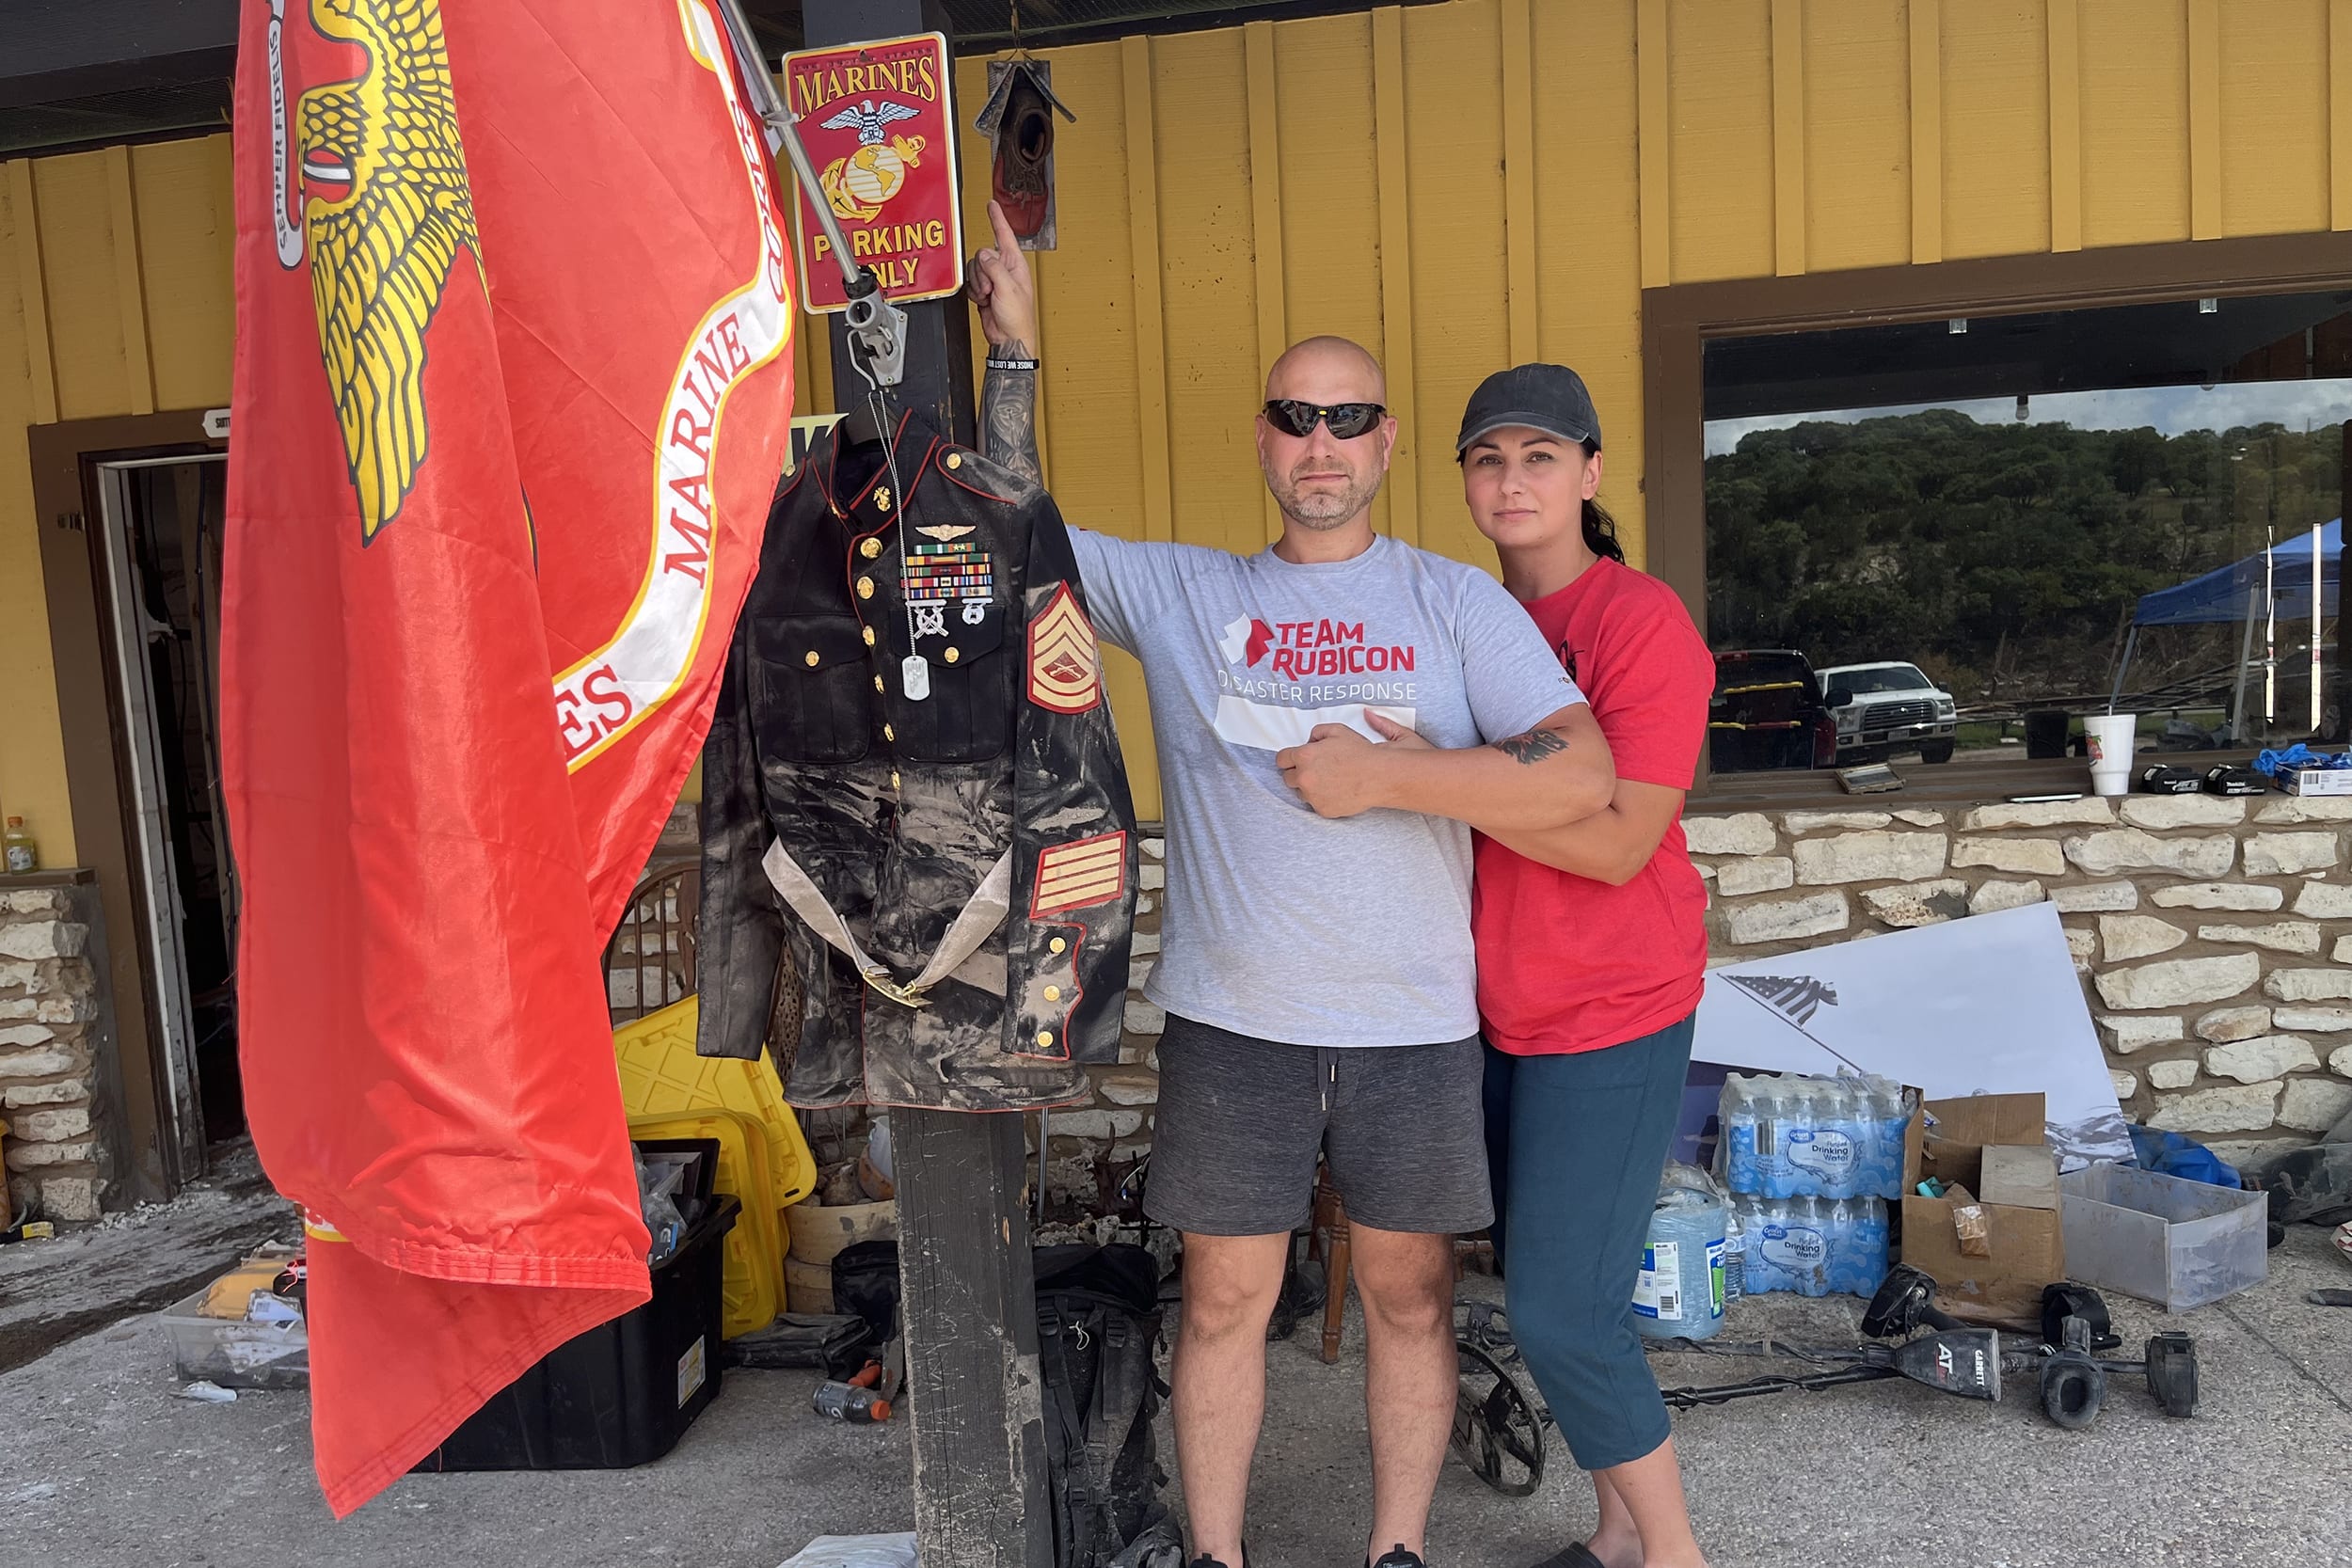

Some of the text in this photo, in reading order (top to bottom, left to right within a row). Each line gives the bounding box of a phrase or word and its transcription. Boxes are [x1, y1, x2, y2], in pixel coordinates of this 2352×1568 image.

[795, 55, 937, 122] MARINES
[269, 29, 289, 250] SEMPER FIDELIS
[813, 219, 945, 262] PRKING
[856, 257, 919, 289] NLY
[994, 360, 1007, 370] LOST
[664, 312, 751, 590] MARINE
[1276, 618, 1364, 648] TEAM
[1272, 645, 1415, 682] RUBICON
[1216, 669, 1417, 704] DISASTER RESPONSE
[1812, 1145, 1849, 1155] Drinking
[1823, 1153, 1849, 1163] Water
[1784, 1241, 1820, 1253] Drinking
[1795, 1250, 1820, 1259] Water
[1938, 1342, 1953, 1375] AT
[1975, 1349, 1986, 1386] GARRETT
